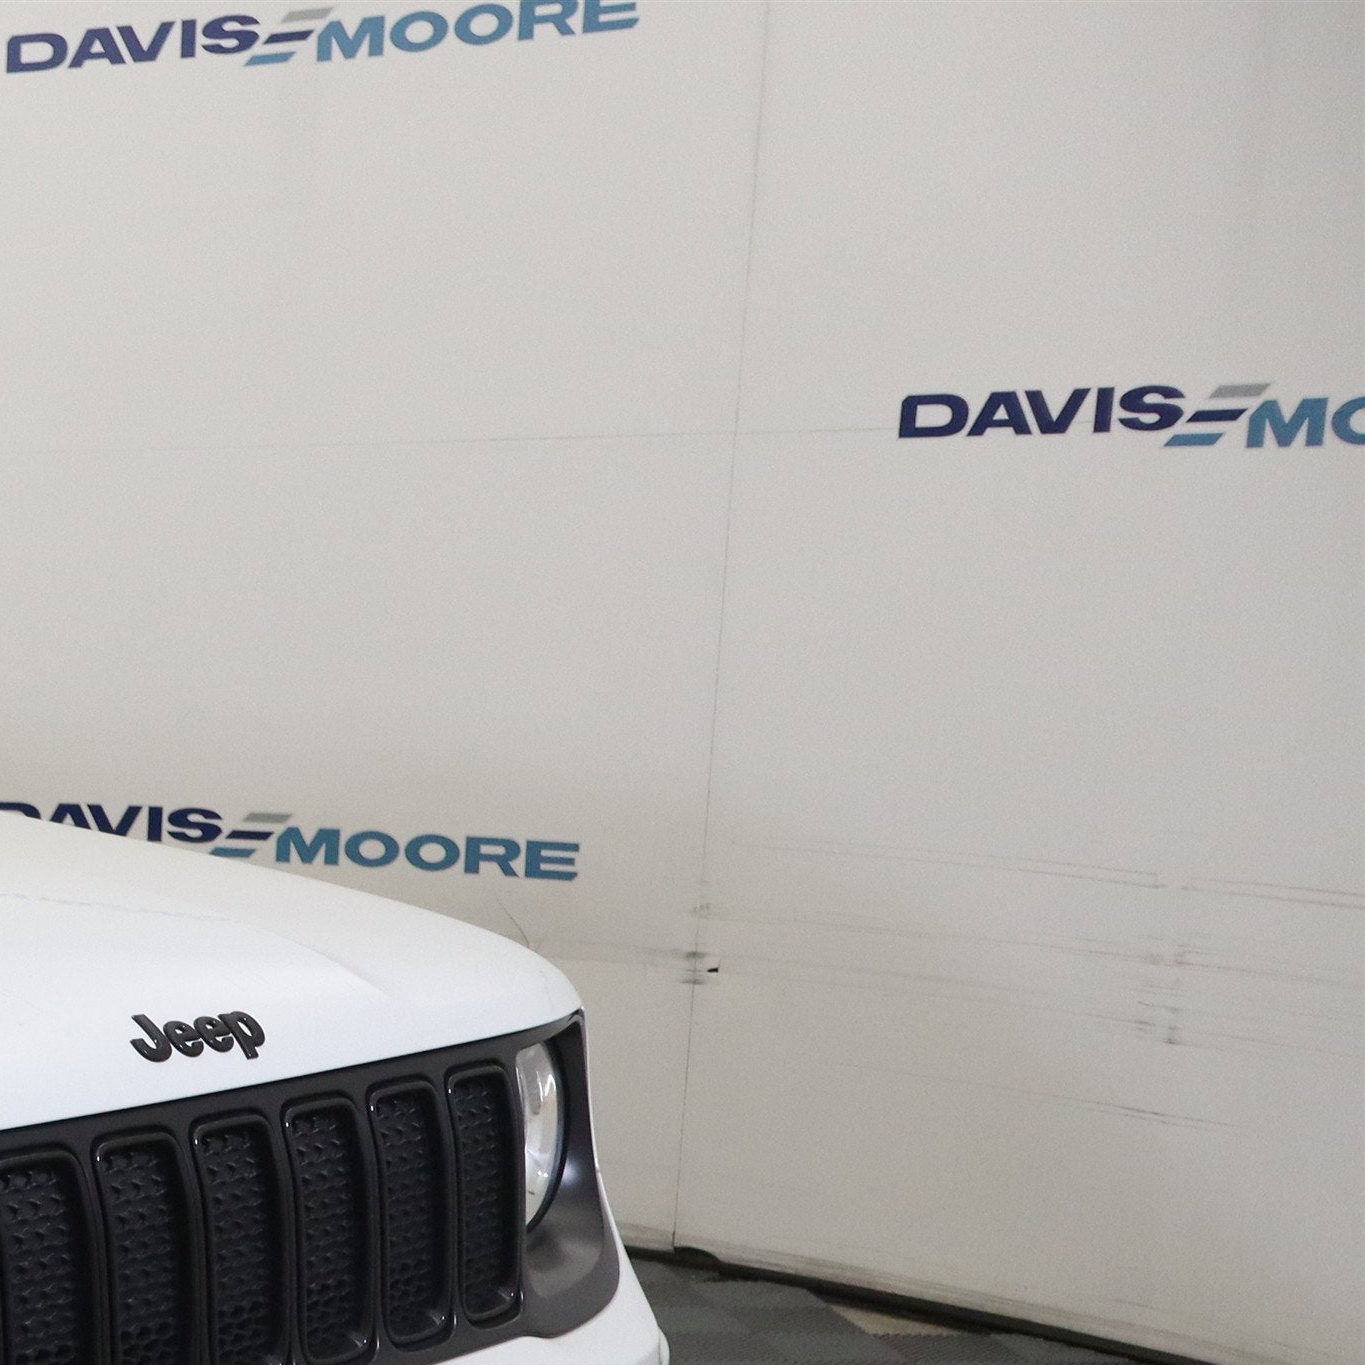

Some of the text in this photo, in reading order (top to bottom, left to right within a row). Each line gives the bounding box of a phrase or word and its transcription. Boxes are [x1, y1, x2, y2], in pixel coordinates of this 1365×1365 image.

[6, 0, 639, 74] DAVIS MOORE
[898, 385, 1184, 439] DAVIS
[275, 826, 579, 882] MOORE
[129, 1011, 266, 1063] Jeep
